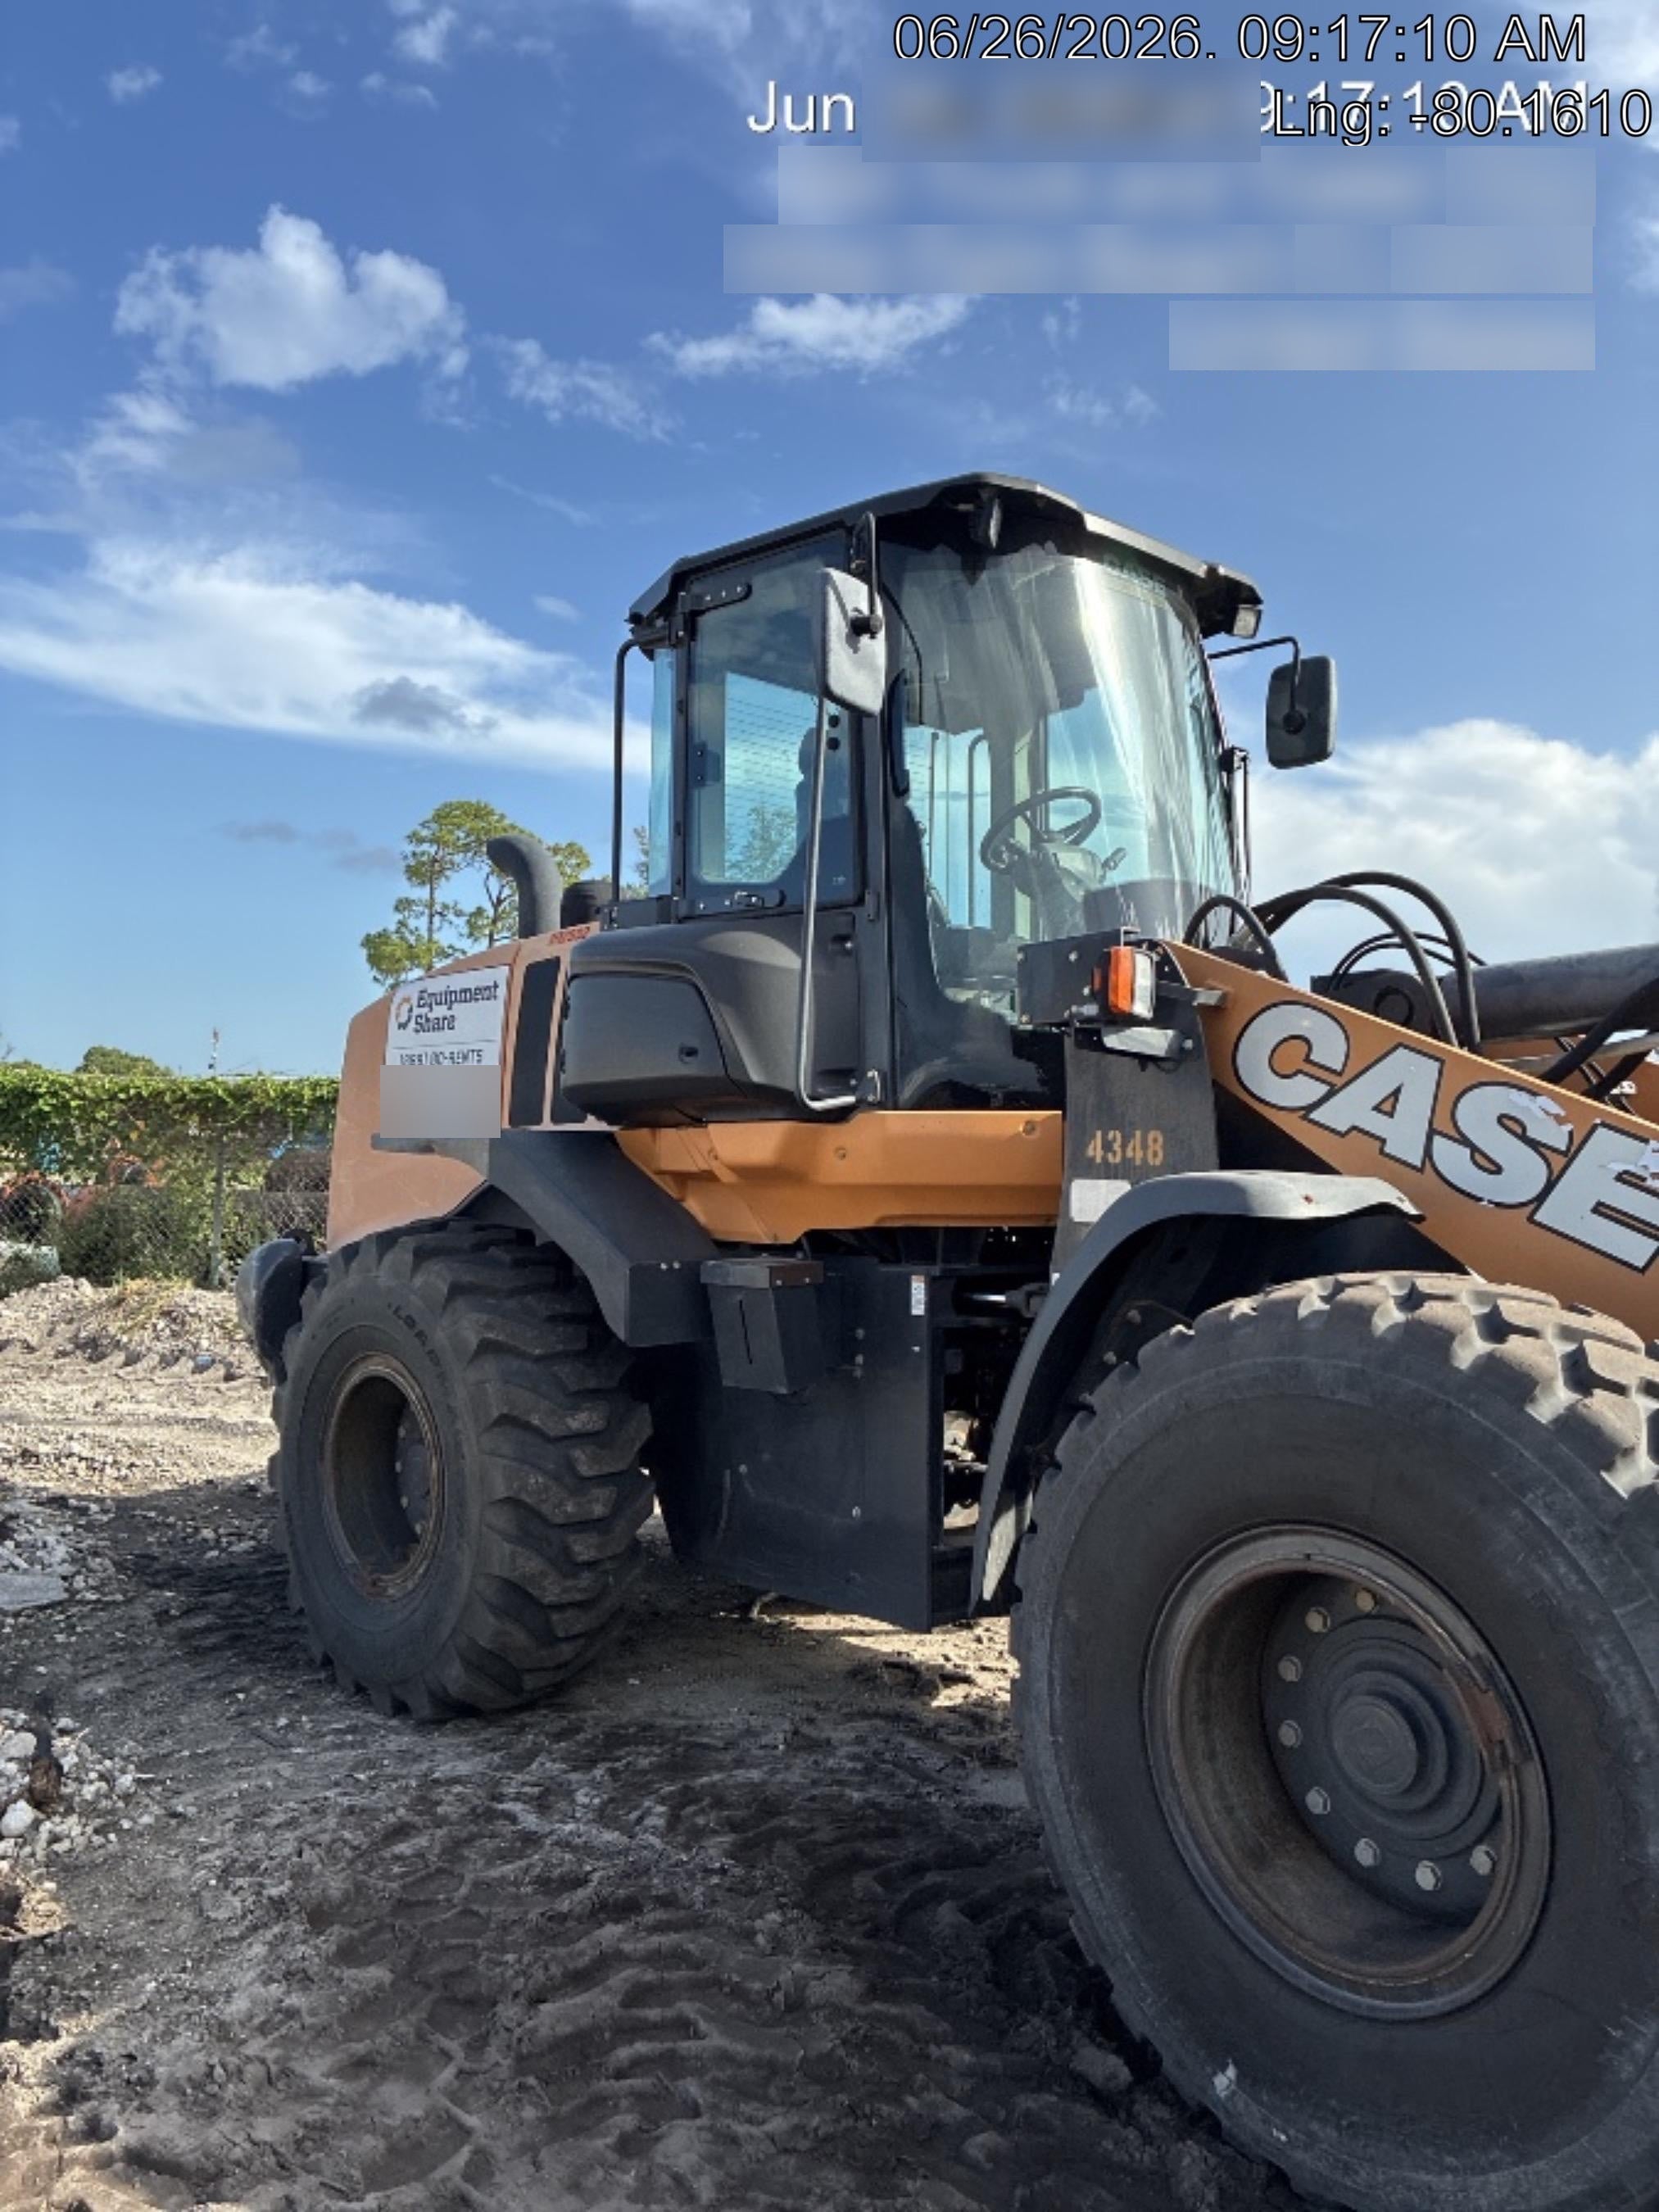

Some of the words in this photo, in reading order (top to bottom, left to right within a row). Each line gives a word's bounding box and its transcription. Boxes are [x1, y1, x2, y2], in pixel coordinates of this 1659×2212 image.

[416, 980, 499, 1013] Equipment
[413, 1012, 456, 1035] Share
[1086, 1129, 1164, 1167] 4348
[1231, 999, 1659, 1274] CASE
